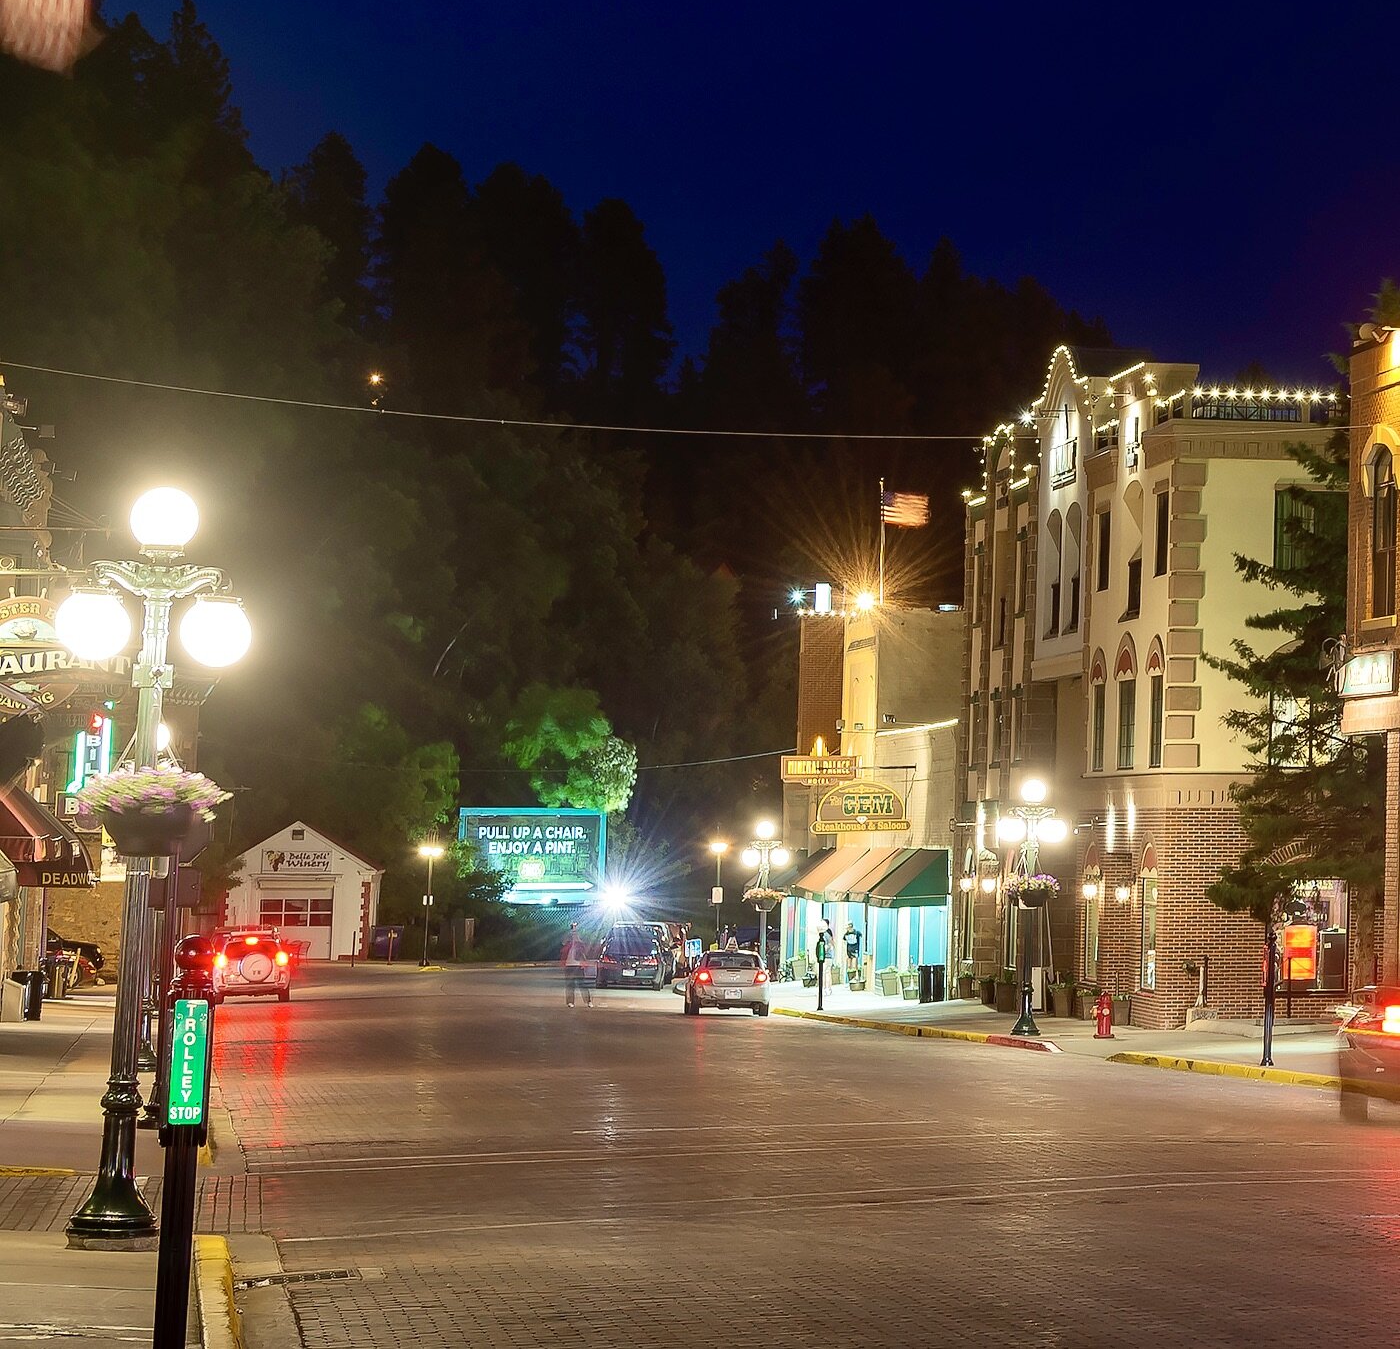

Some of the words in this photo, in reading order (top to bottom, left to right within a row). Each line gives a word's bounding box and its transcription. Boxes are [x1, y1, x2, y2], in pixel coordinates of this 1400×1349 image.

[0, 650, 131, 675] AURANT
[843, 794, 894, 816] GEM
[478, 826, 510, 839] PULL
[513, 826, 531, 839] UP
[533, 827, 543, 838] A
[545, 826, 587, 839] CHAIR.
[816, 822, 866, 832] Steakhouse
[877, 822, 908, 830] Saloon
[489, 841, 528, 854] ENJOY
[533, 841, 544, 853] A
[545, 841, 576, 854] PINT.
[286, 859, 330, 872] Winery
[180, 1004, 197, 1103] TROLLEY
[169, 1106, 201, 1120] STOP
